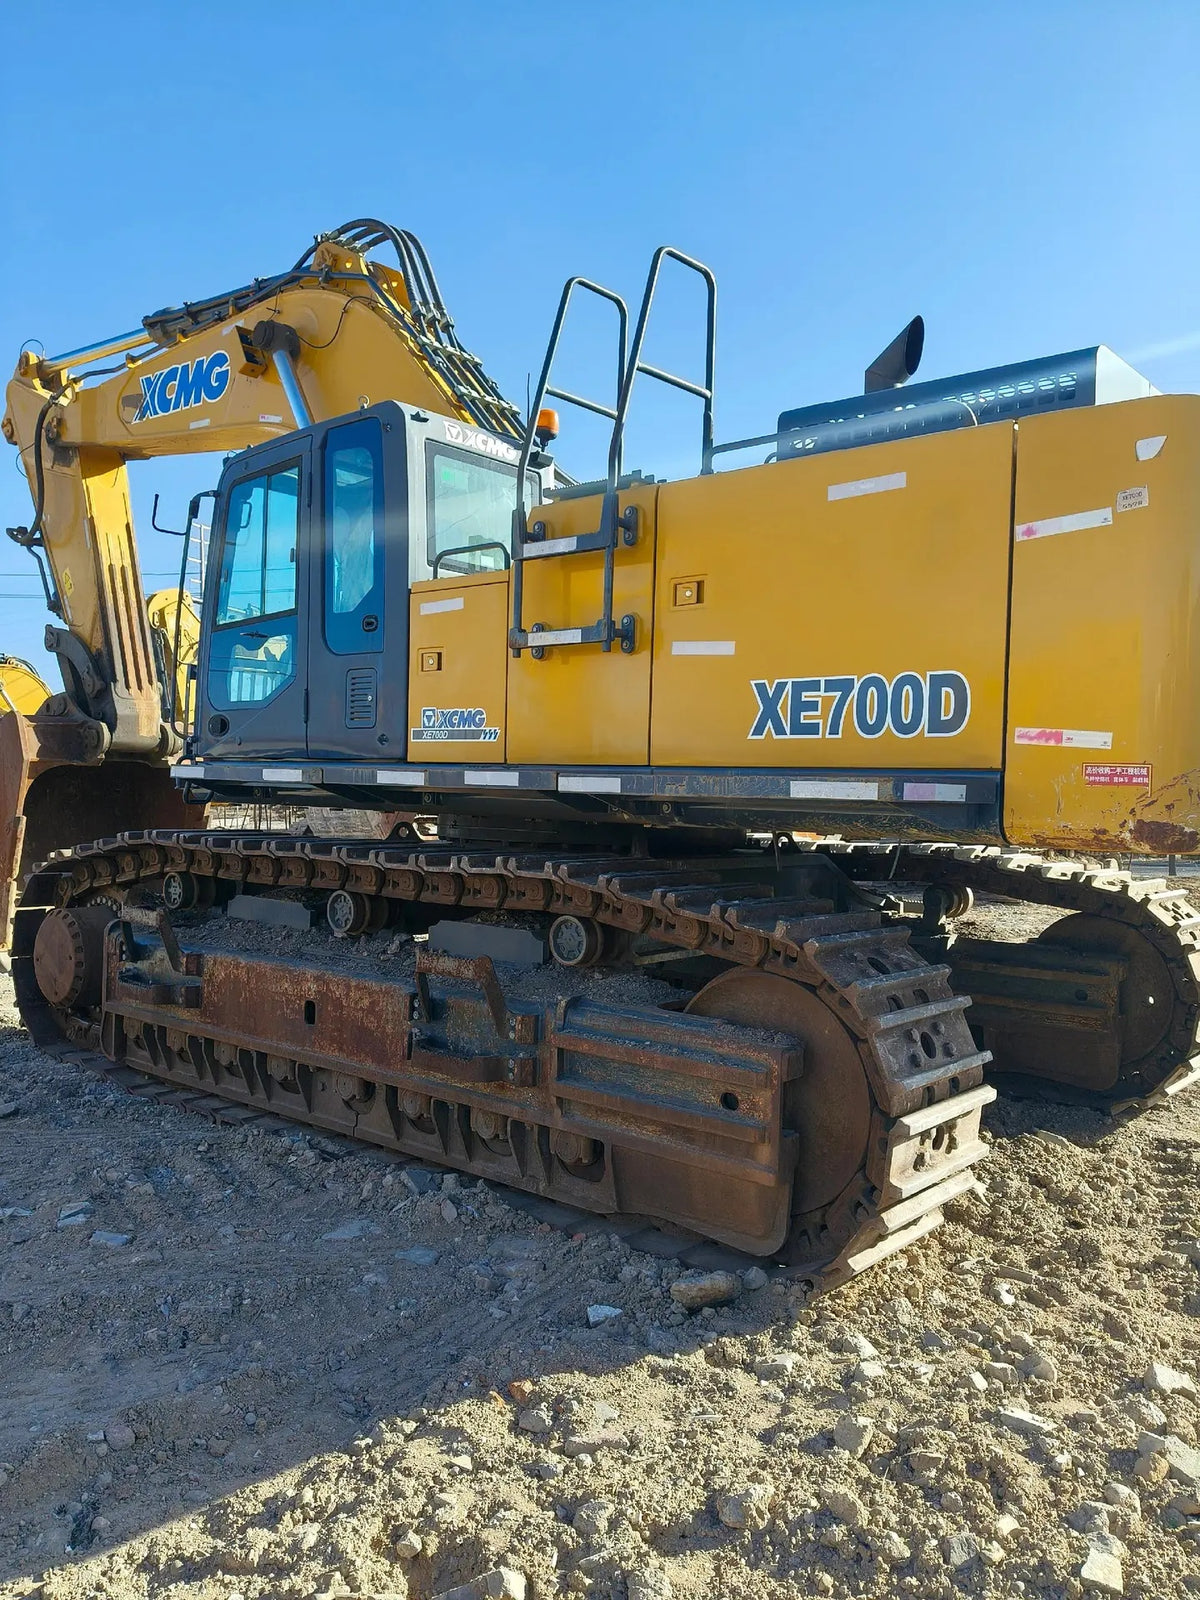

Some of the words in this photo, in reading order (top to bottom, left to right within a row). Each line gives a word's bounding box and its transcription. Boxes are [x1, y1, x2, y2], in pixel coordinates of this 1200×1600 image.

[132, 350, 230, 424] XCMG
[463, 429, 517, 460] XCMG
[436, 708, 486, 729] XCMG
[748, 670, 970, 740] XE700D
[422, 731, 448, 739] XE700D
